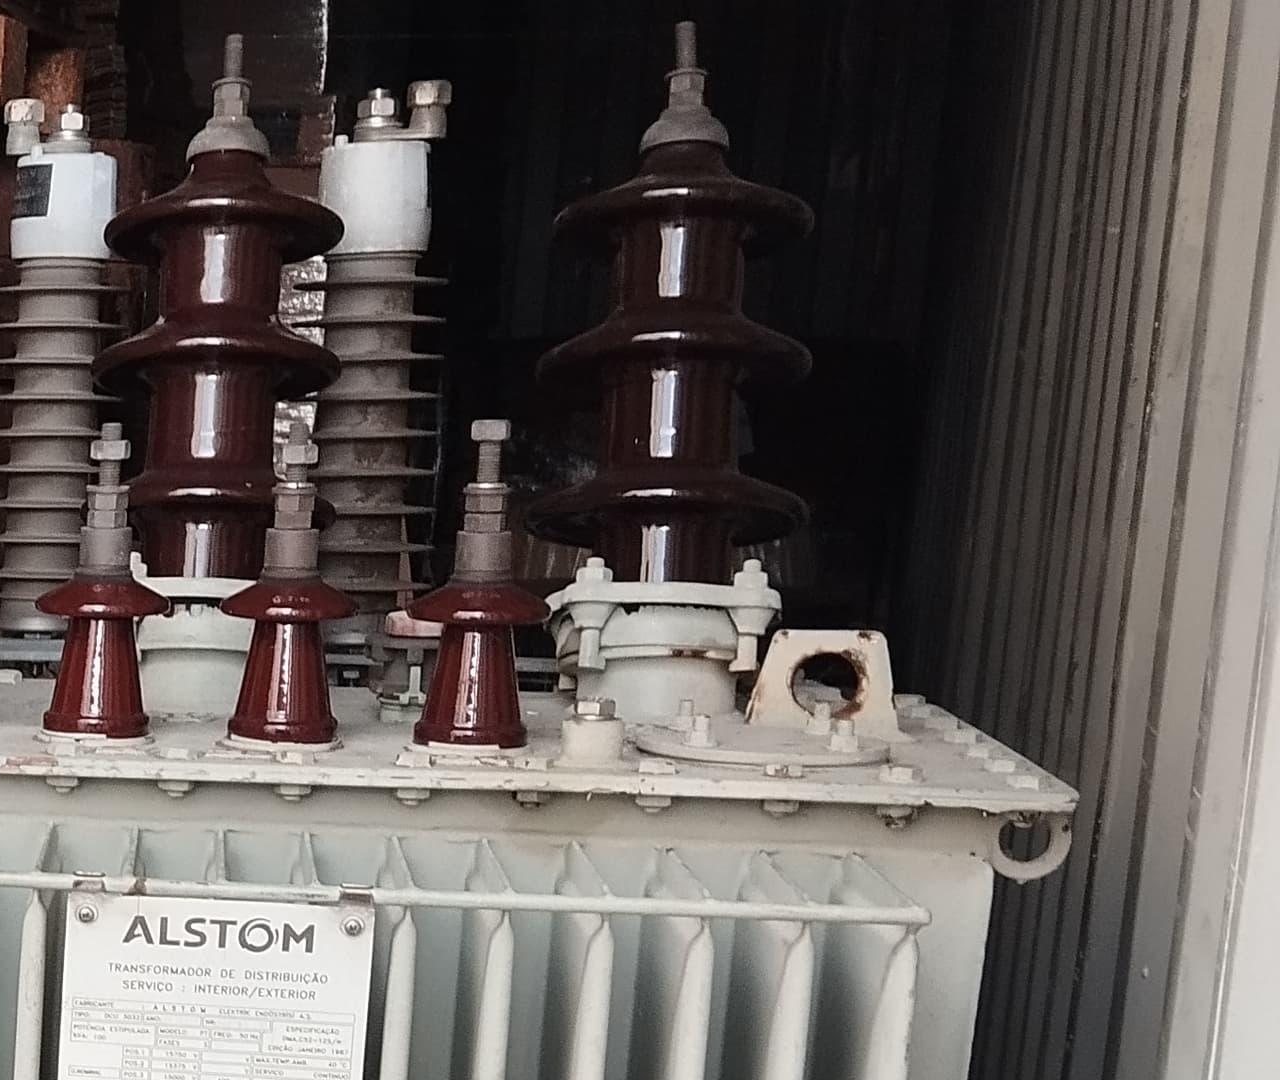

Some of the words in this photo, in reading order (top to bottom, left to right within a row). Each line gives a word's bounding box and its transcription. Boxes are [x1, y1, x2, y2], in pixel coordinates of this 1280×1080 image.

[122, 914, 315, 953] ALSTOM
[108, 961, 212, 977] TRANSFORMADOR
[220, 968, 234, 979] DE
[243, 967, 328, 986] DISTRIBUIÇÃO
[121, 979, 173, 993] SERVIÇO
[193, 983, 316, 1002] INTERIOR/EXTERIOR
